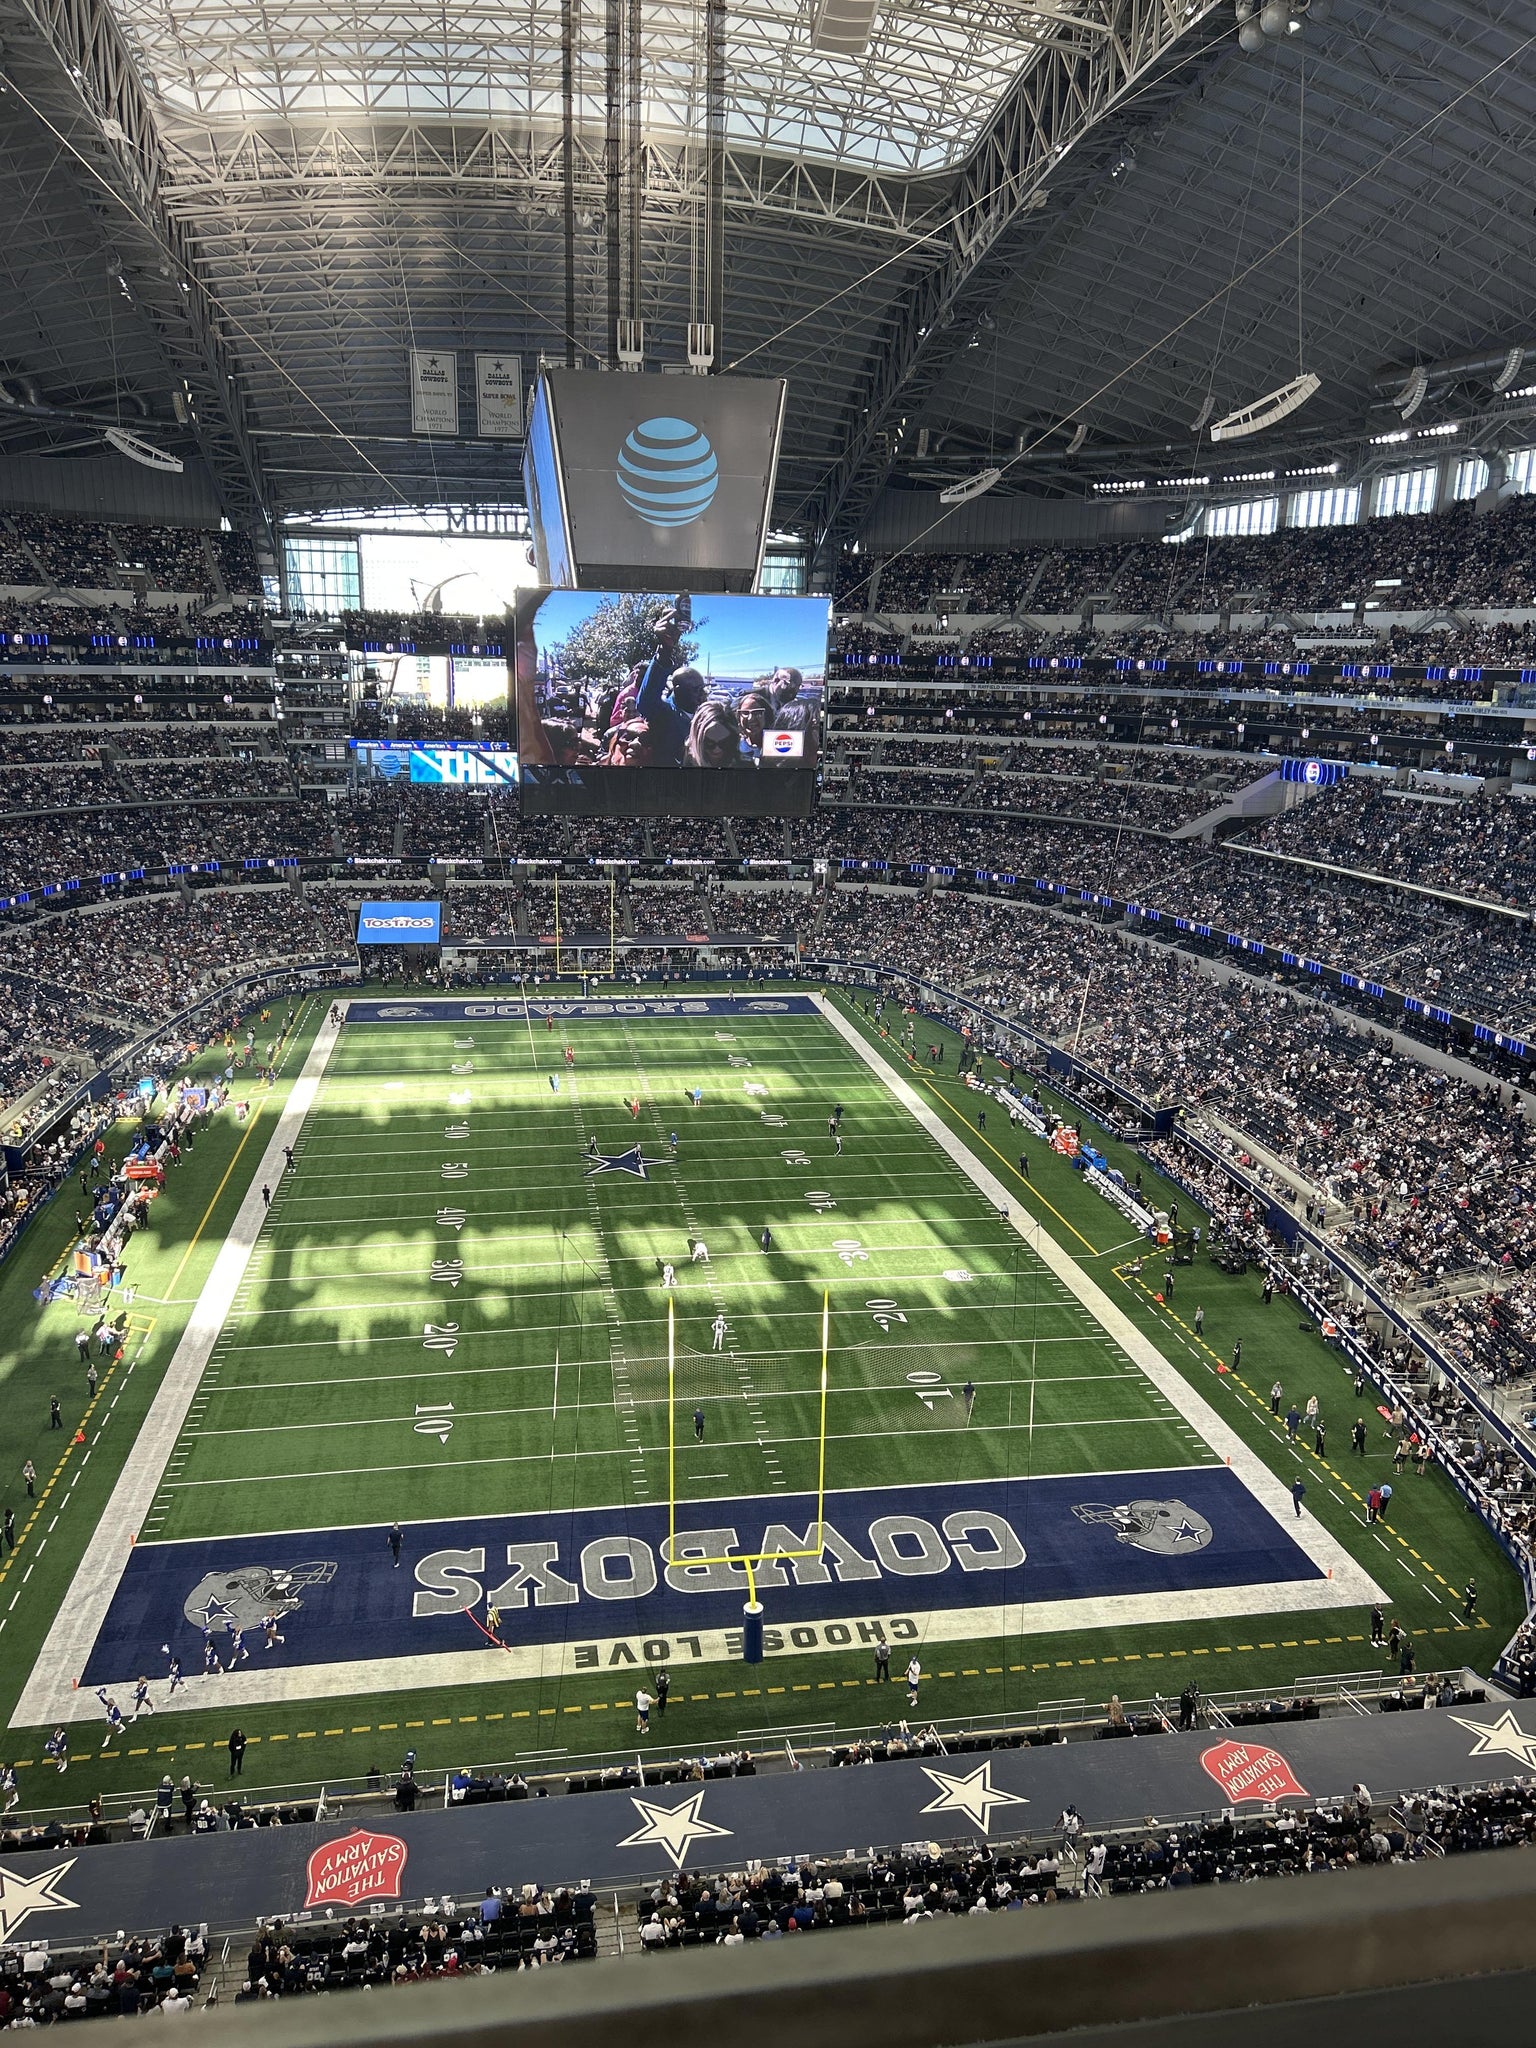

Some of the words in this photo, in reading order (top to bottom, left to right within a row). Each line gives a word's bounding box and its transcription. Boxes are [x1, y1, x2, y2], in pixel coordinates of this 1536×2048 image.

[416, 416, 454, 424] CHAMPIONS
[482, 418, 520, 426] CHAMPIONS
[1456, 706, 1470, 714] CHUCK
[464, 1002, 710, 1016] COWBOYS
[444, 1125, 470, 1138] 40
[761, 1114, 788, 1128] 40
[781, 1150, 812, 1164] 50
[441, 1162, 468, 1178] 50
[804, 1191, 838, 1208] 40
[436, 1206, 466, 1225] 40
[832, 1240, 869, 1260] 30
[430, 1260, 464, 1281] 30
[865, 1299, 908, 1324] 20
[422, 1322, 460, 1349] 20
[906, 1372, 954, 1399] 10
[414, 1402, 454, 1434] 10
[412, 1510, 1027, 1617] COWBOYS
[724, 1618, 919, 1655] CHOOSE
[574, 1636, 702, 1669] LOVE
[1218, 1746, 1250, 1778] ARMY
[1225, 1752, 1281, 1797] SALVATION
[1257, 1774, 1286, 1796] THE
[320, 1837, 374, 1876] ARMY
[315, 1844, 400, 1898] SALVATION
[347, 1870, 385, 1898] THE
